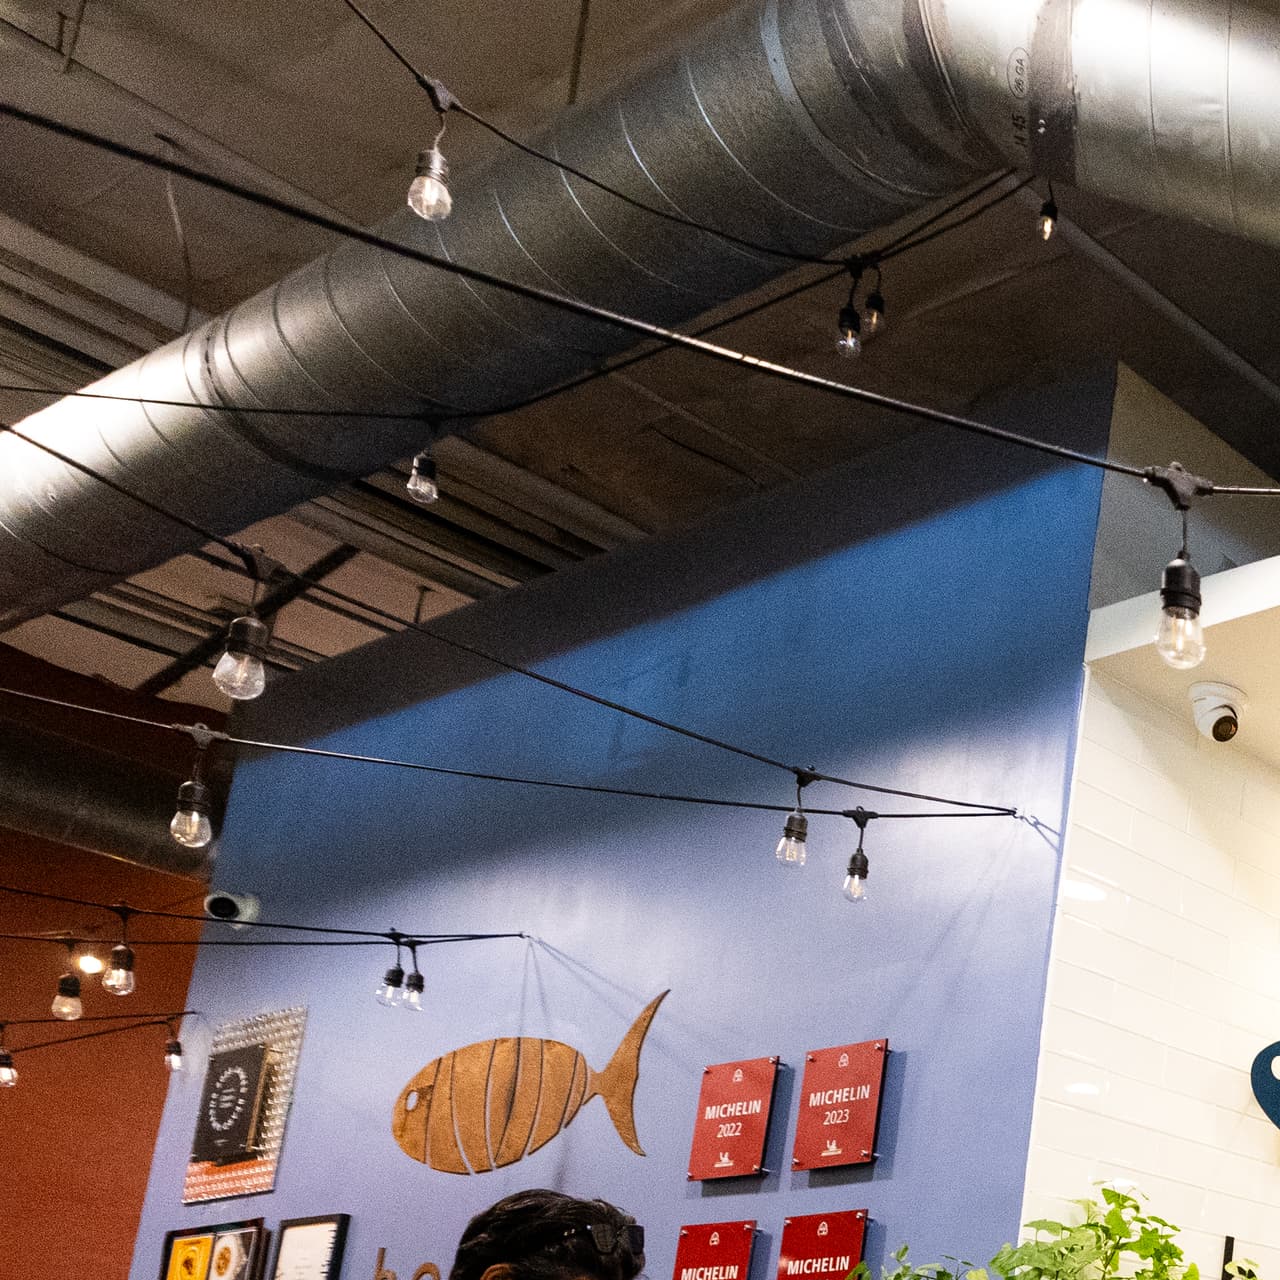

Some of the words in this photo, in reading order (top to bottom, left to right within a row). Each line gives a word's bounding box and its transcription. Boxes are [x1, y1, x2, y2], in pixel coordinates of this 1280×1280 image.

[809, 1084, 870, 1107] MICHELIN
[705, 1100, 761, 1119] MICHELIN
[823, 1108, 849, 1125] 2023
[716, 1122, 742, 1138] 2022
[787, 1255, 850, 1276] MICHELIN
